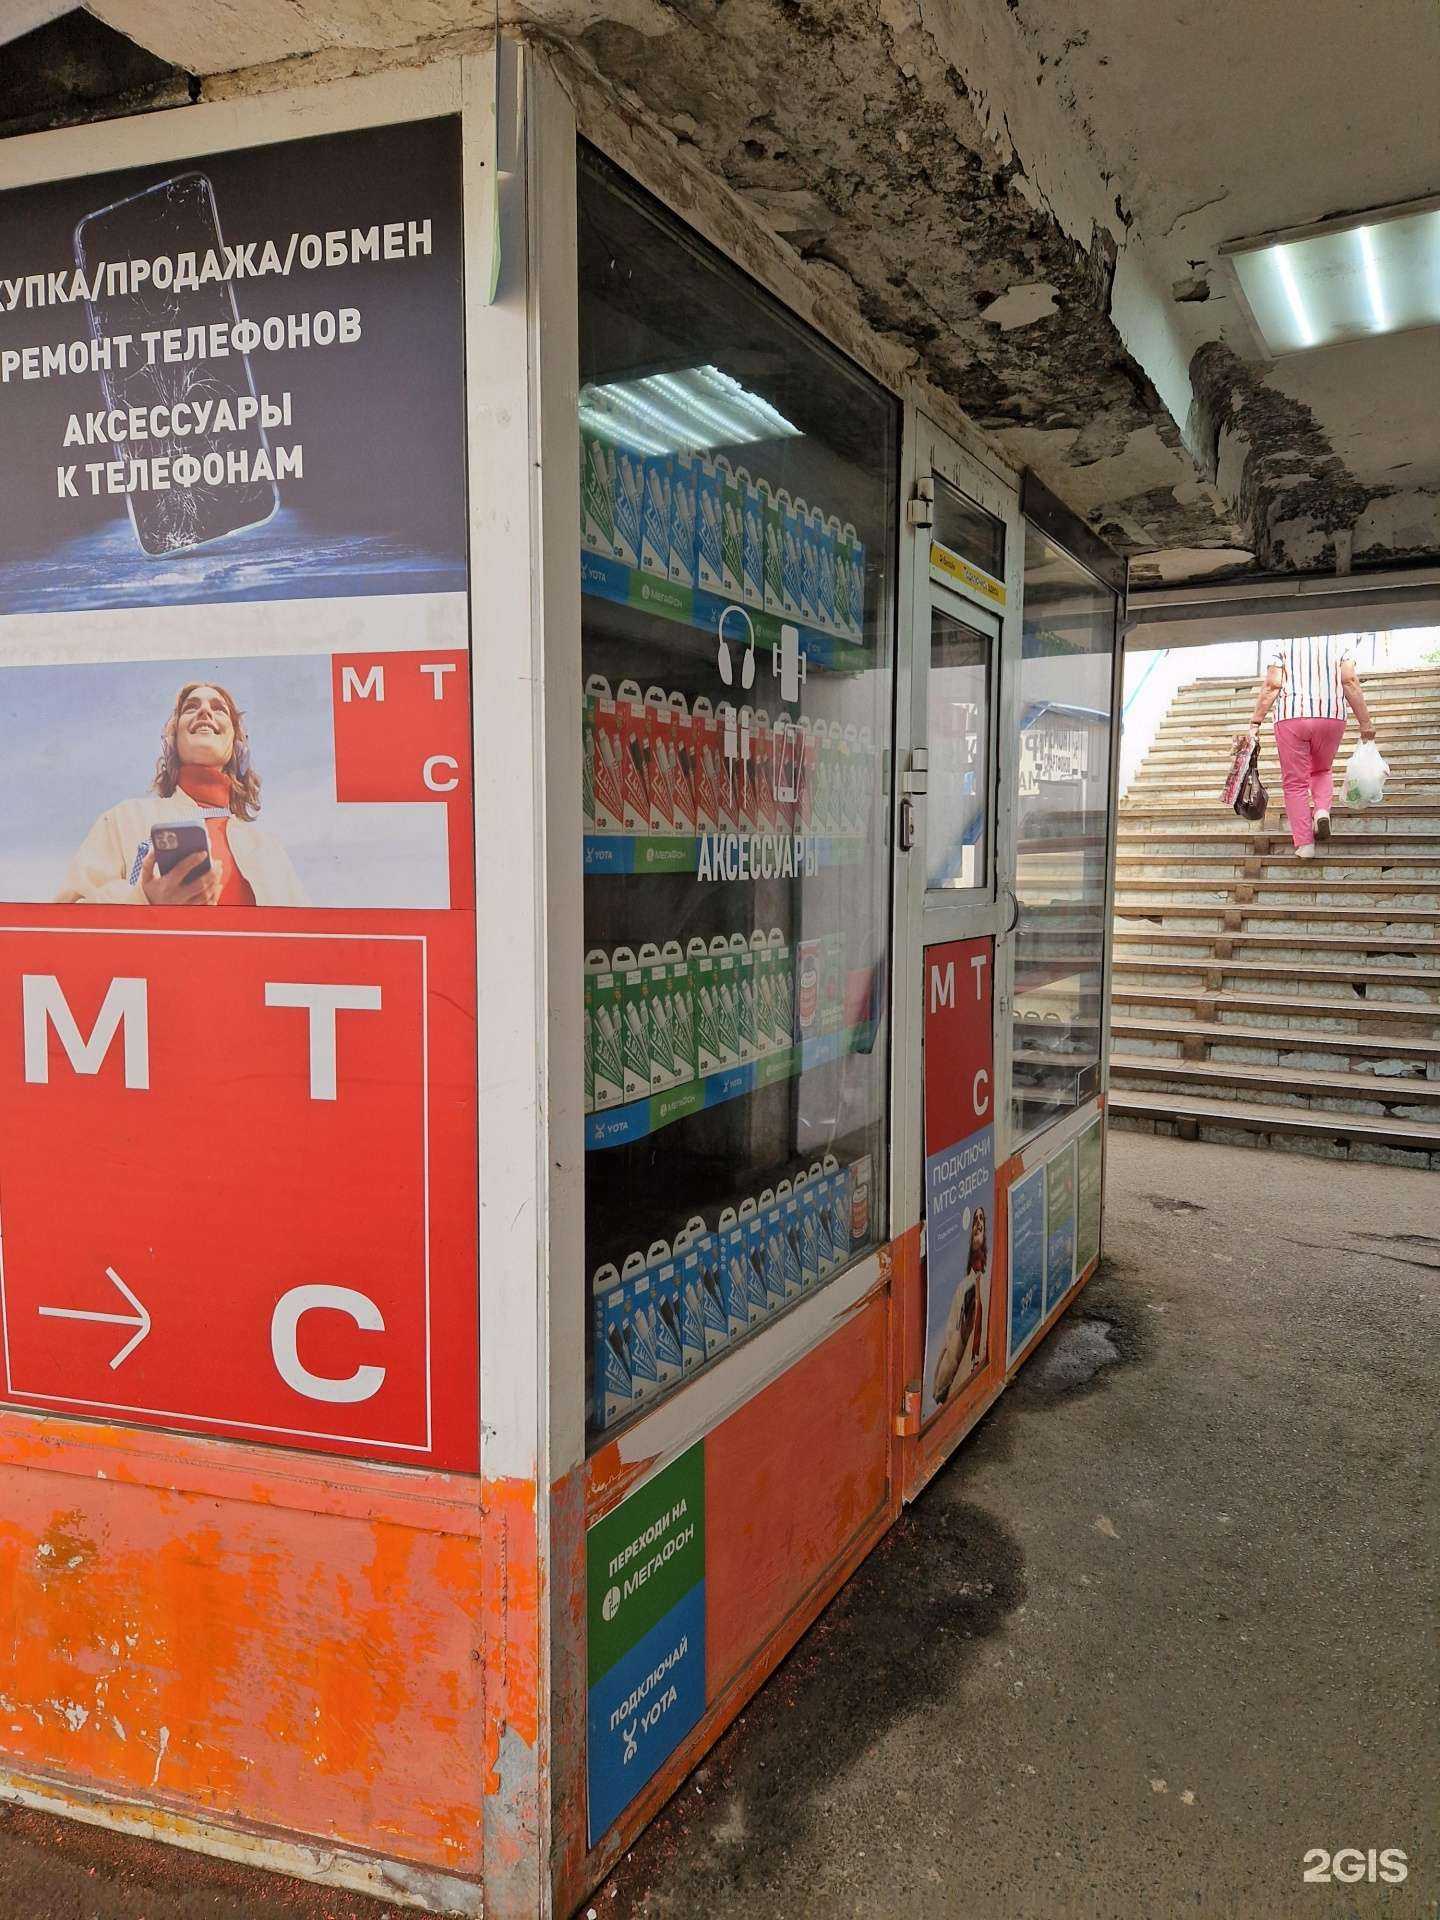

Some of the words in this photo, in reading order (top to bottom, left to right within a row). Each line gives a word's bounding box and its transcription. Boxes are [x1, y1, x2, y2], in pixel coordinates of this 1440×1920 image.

[0, 219, 432, 311] УПКА/ПРОДАЖА/ОБМЕН
[2, 336, 133, 382] РЕМОНТ
[141, 307, 362, 366] ТЕЛЕФОНОВ
[62, 392, 292, 447] АКСЕССУАРЫ
[56, 465, 79, 497] К
[85, 445, 304, 496] ТЕЛЕФОНАМ
[697, 832, 820, 882] АКСЕССУАРЫ
[607, 1120, 629, 1134] YOTA
[933, 1135, 991, 1186] ПОДКЛЮЧИ
[933, 1185, 957, 1216] МТС
[958, 1166, 989, 1200] ЗДЕСЬ
[609, 1512, 670, 1578] ПЕРЕХОДИ
[672, 1498, 688, 1522] НА
[623, 1523, 694, 1600] МЕГАФОН
[610, 1634, 688, 1731] ПОДКЛЮЧАЙ
[641, 1685, 678, 1734] YOTA
